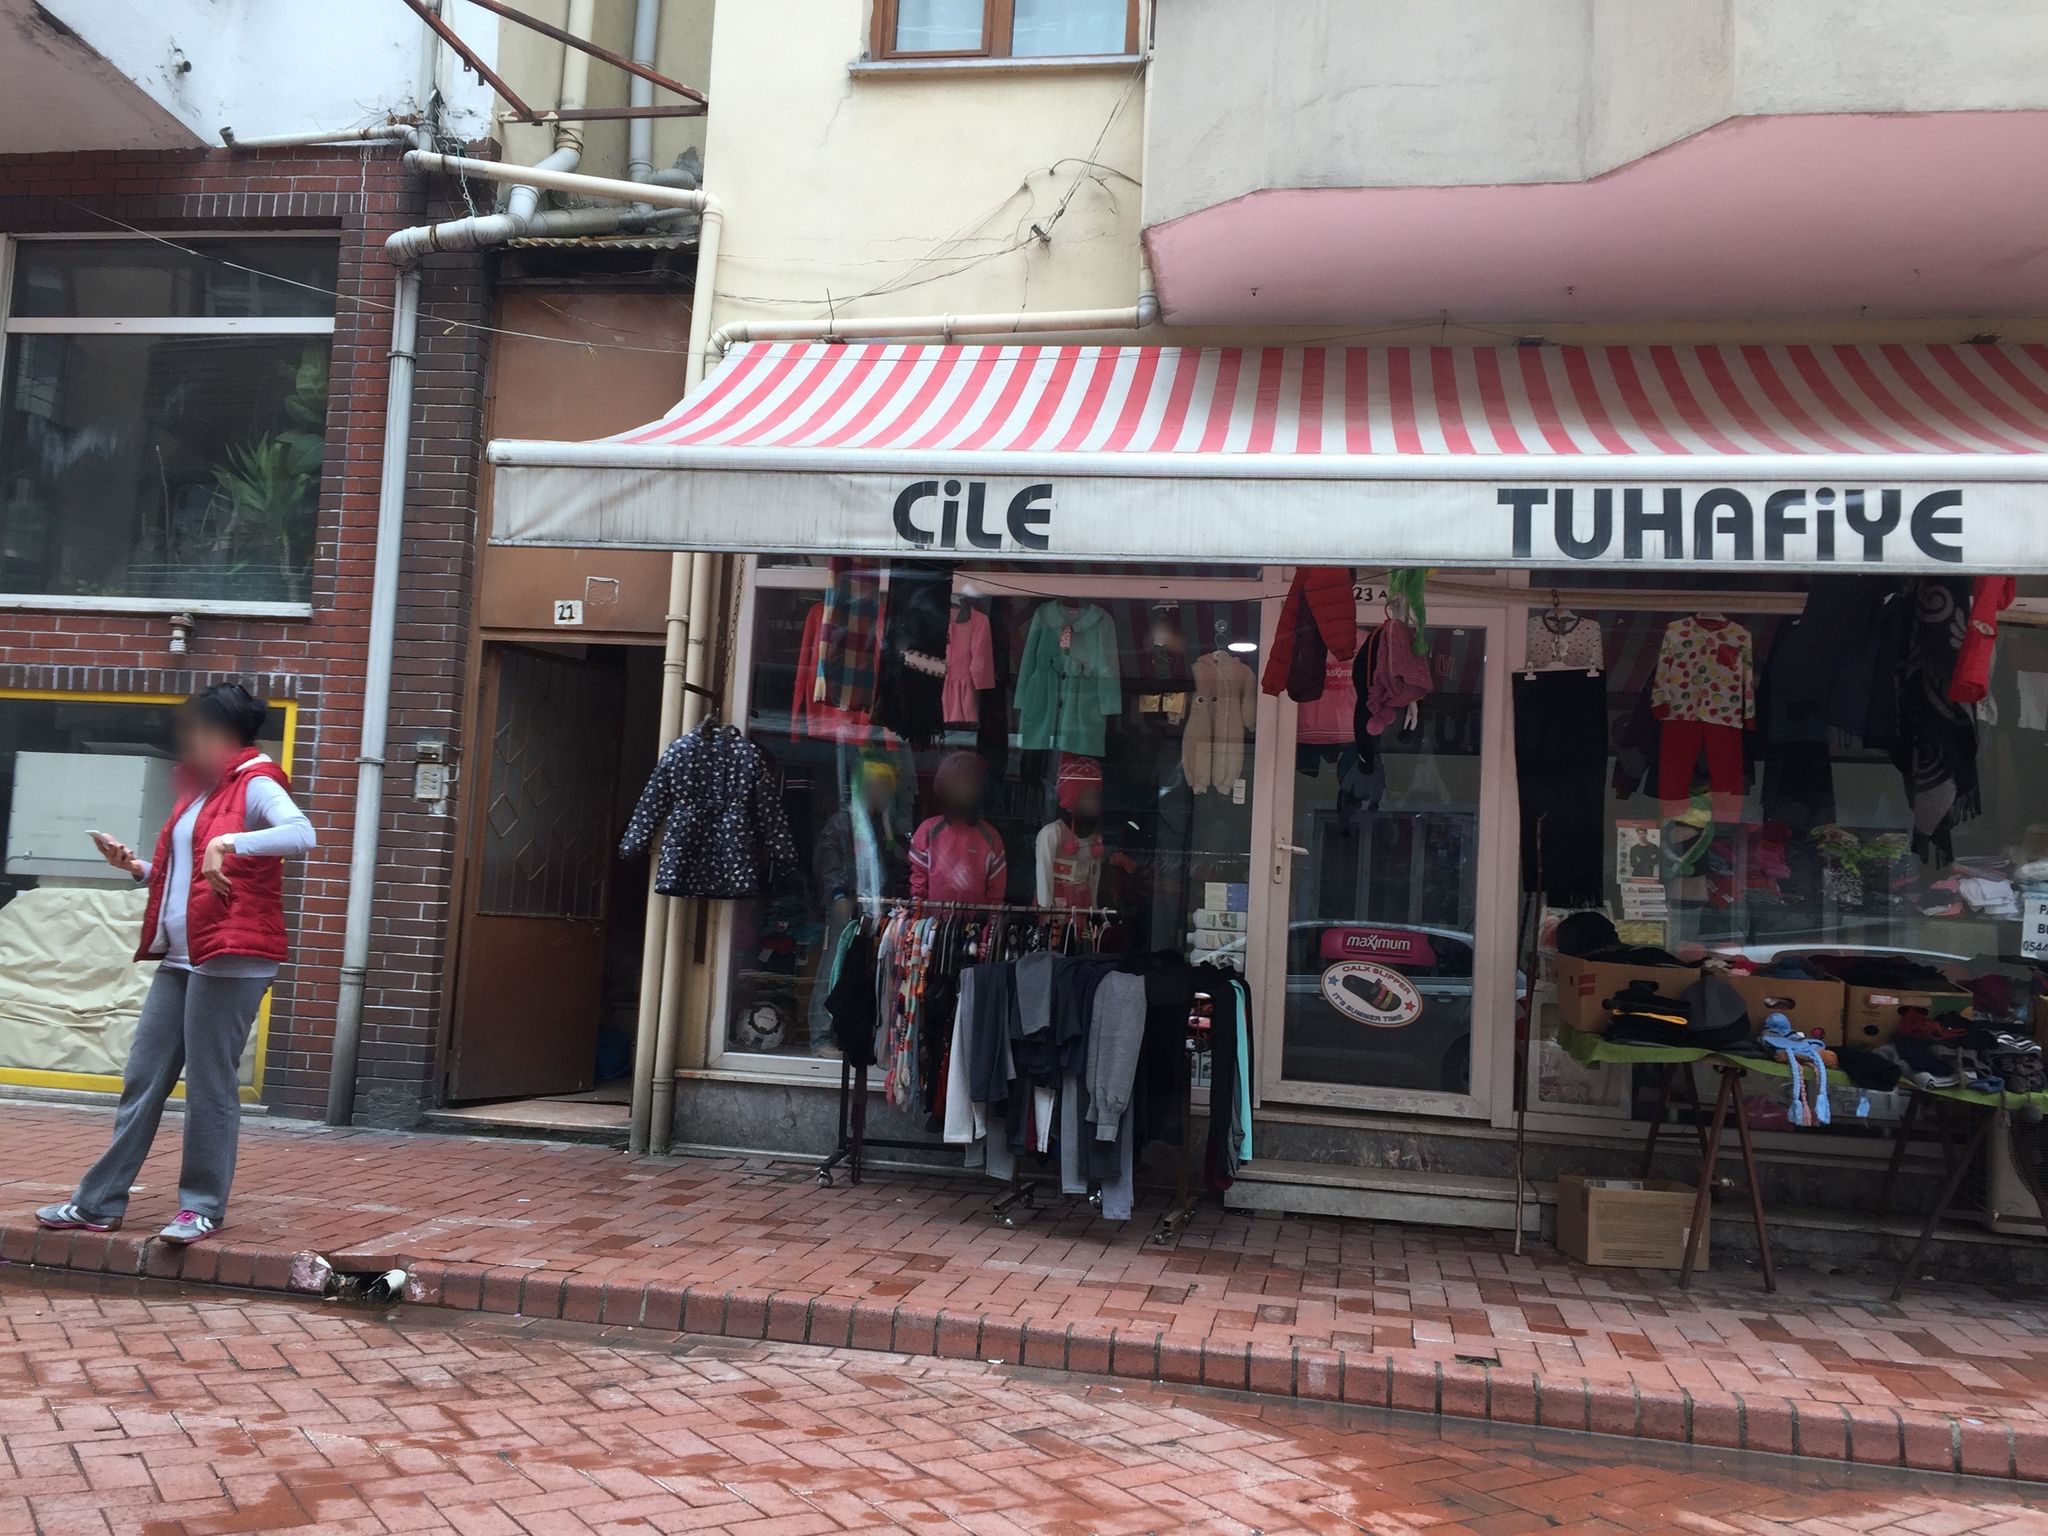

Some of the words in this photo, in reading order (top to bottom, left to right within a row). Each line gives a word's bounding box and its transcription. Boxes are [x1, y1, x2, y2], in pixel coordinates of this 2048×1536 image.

[1352, 586, 1373, 601] 23
[1378, 589, 1387, 599] A
[557, 603, 575, 621] 21
[2039, 904, 2048, 915] P
[1372, 968, 1412, 995] SLIPPER
[1345, 1004, 1382, 1022] SUMMER
[1382, 1013, 1405, 1022] TIME
